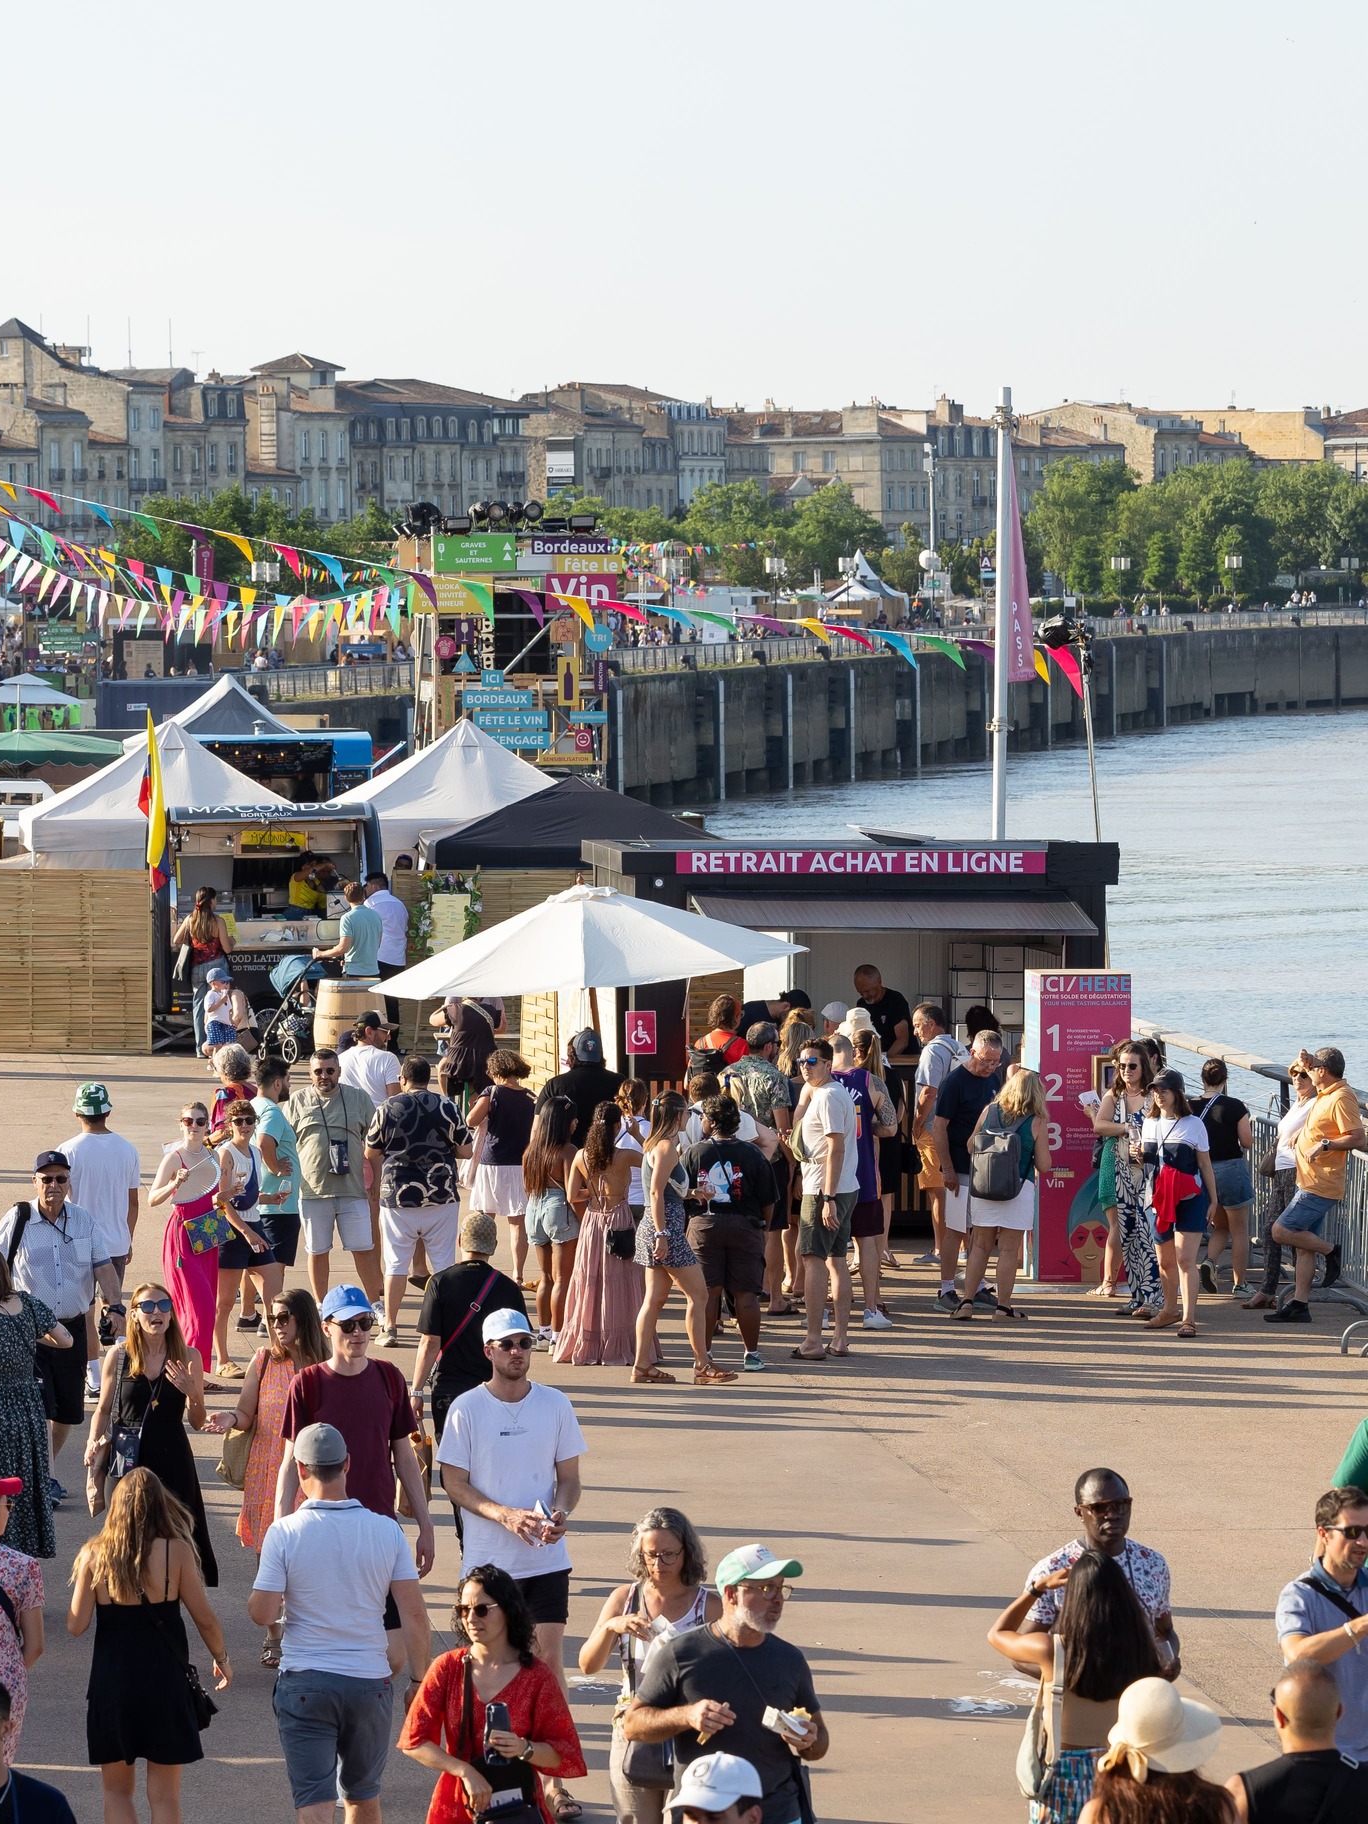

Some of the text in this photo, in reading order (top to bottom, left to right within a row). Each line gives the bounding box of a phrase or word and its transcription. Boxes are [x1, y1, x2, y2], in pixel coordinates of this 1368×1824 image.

[534, 540, 606, 553] Bordeaux
[564, 558, 618, 572] fête le
[981, 557, 990, 567] A
[550, 576, 610, 605] Vin
[1012, 602, 1023, 667] PASS
[485, 674, 499, 683] ICI
[466, 695, 528, 704] BORDEAUX
[479, 714, 543, 725] FÊTE LE VIN
[493, 735, 544, 745] S'ENGAGE
[188, 804, 343, 814] MACONDO
[691, 852, 1024, 872] RETRAIT ACHAT EN LIGNE
[1040, 976, 1131, 992] ICI/HERE
[1046, 1024, 1060, 1052] 1
[1045, 1074, 1064, 1102] 2
[1047, 1123, 1062, 1151] 3
[1046, 1179, 1064, 1188] Vin
